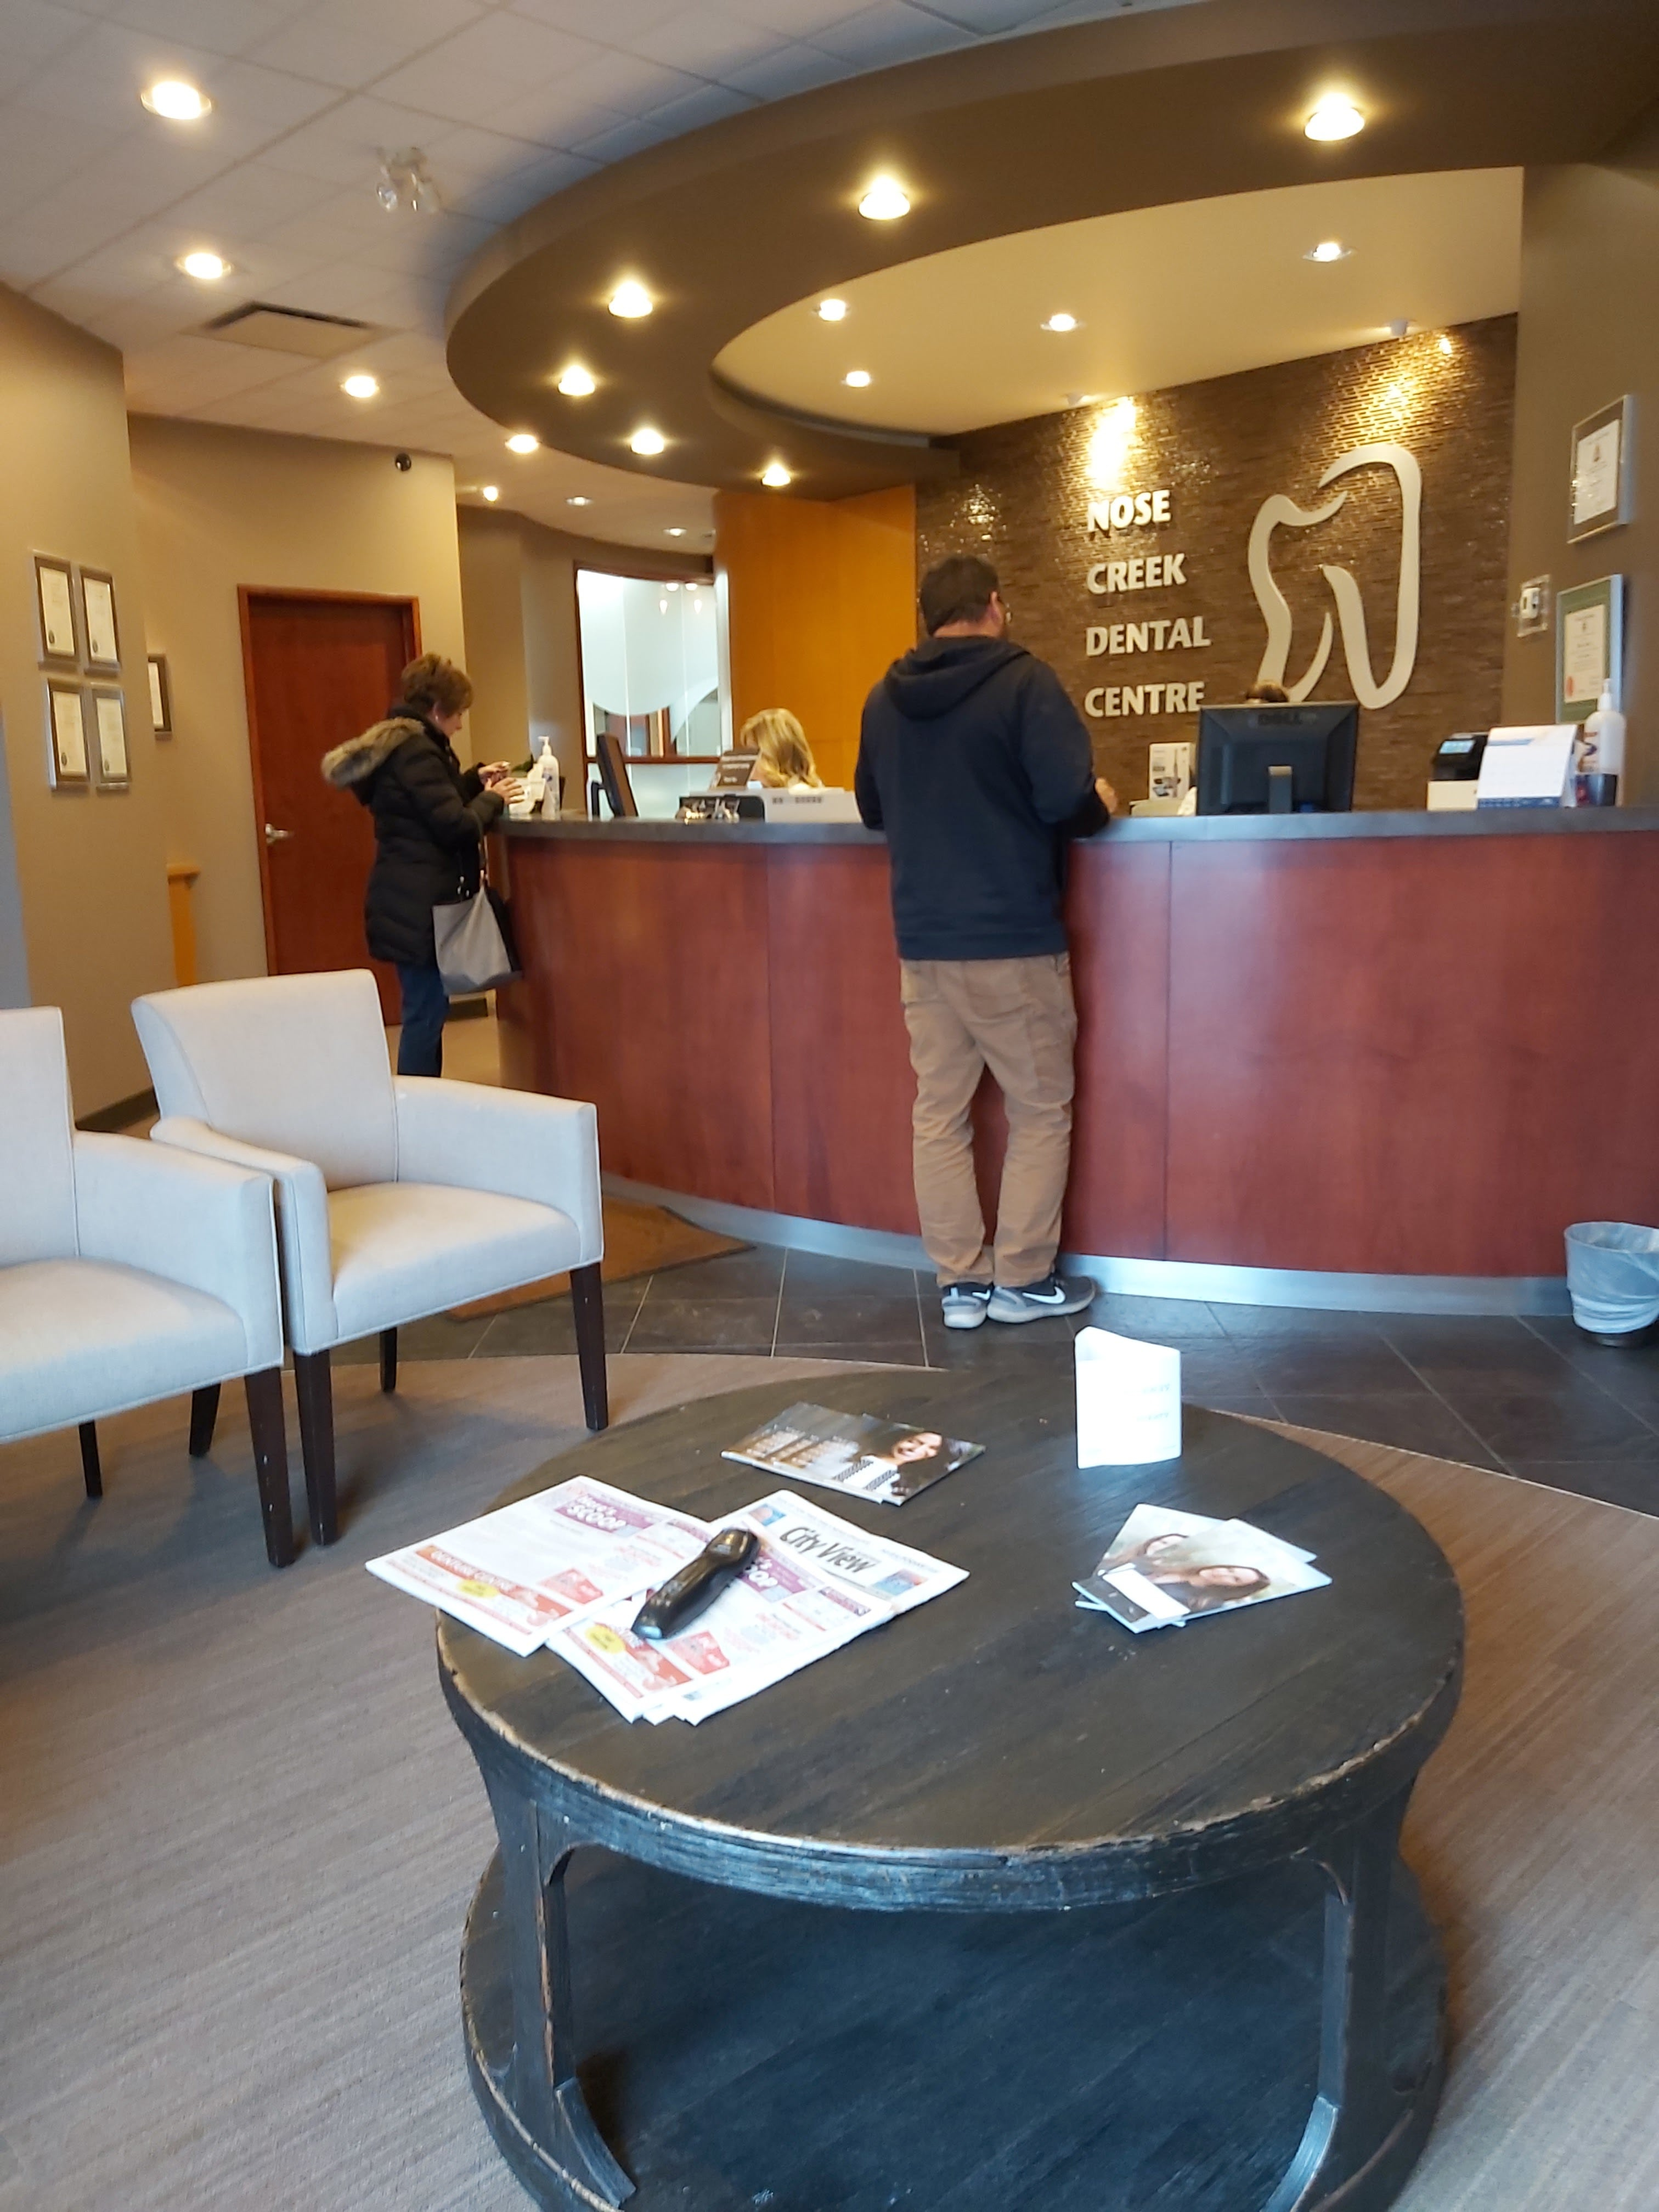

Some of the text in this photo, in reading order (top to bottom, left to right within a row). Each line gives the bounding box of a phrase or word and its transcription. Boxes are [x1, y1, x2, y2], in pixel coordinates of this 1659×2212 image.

[1087, 490, 1171, 532] NOSE
[1086, 553, 1187, 594] CREEK
[1086, 616, 1211, 657] DENTAL
[1084, 681, 1205, 717] CENTRE
[779, 1527, 827, 1554] City
[817, 1542, 877, 1573] View
